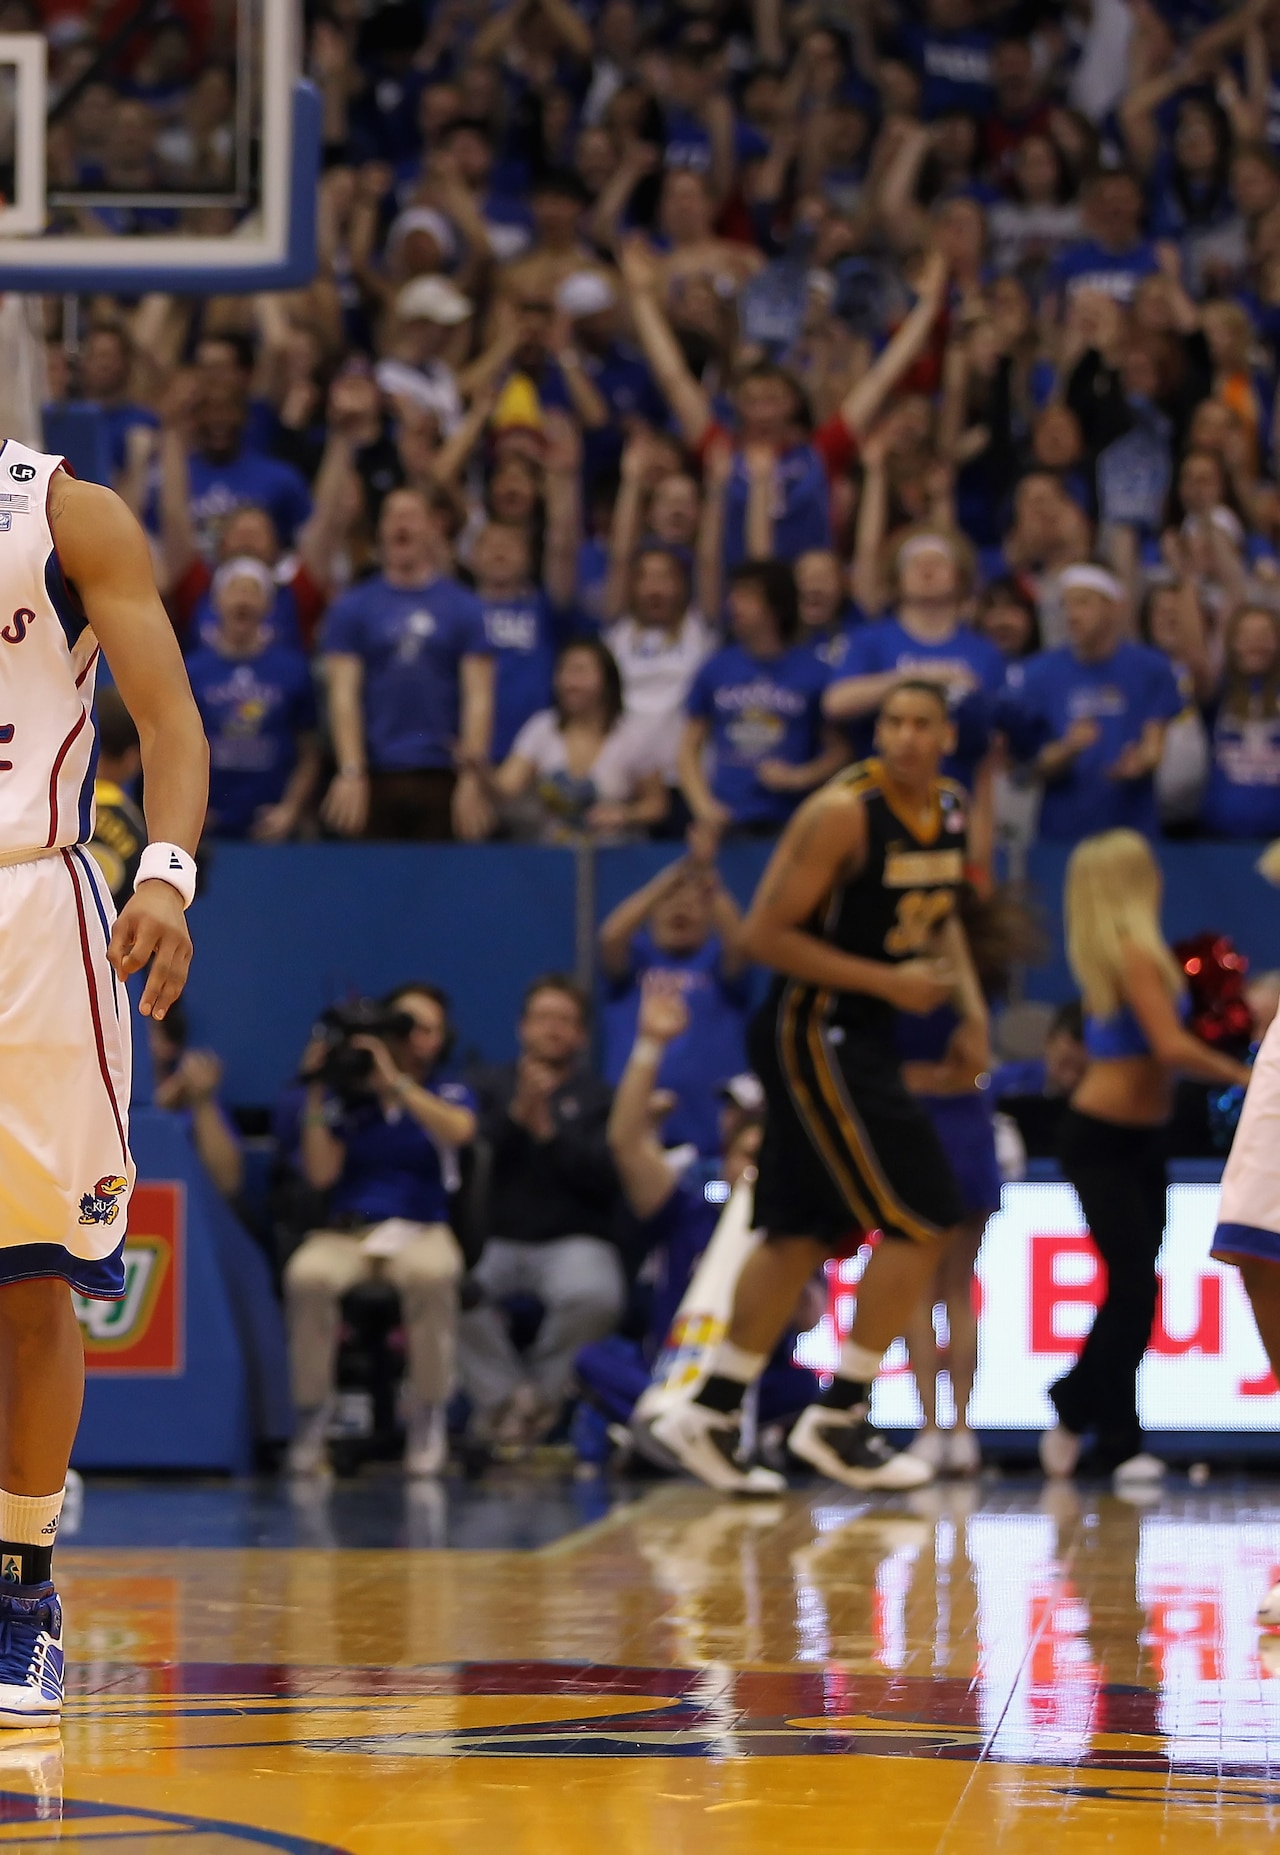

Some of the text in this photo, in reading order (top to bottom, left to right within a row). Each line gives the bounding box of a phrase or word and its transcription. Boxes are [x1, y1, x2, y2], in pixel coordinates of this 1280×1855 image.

[11, 465, 34, 479] LR
[92, 1201, 107, 1212] KU
[1031, 1234, 1280, 1396] Bu
